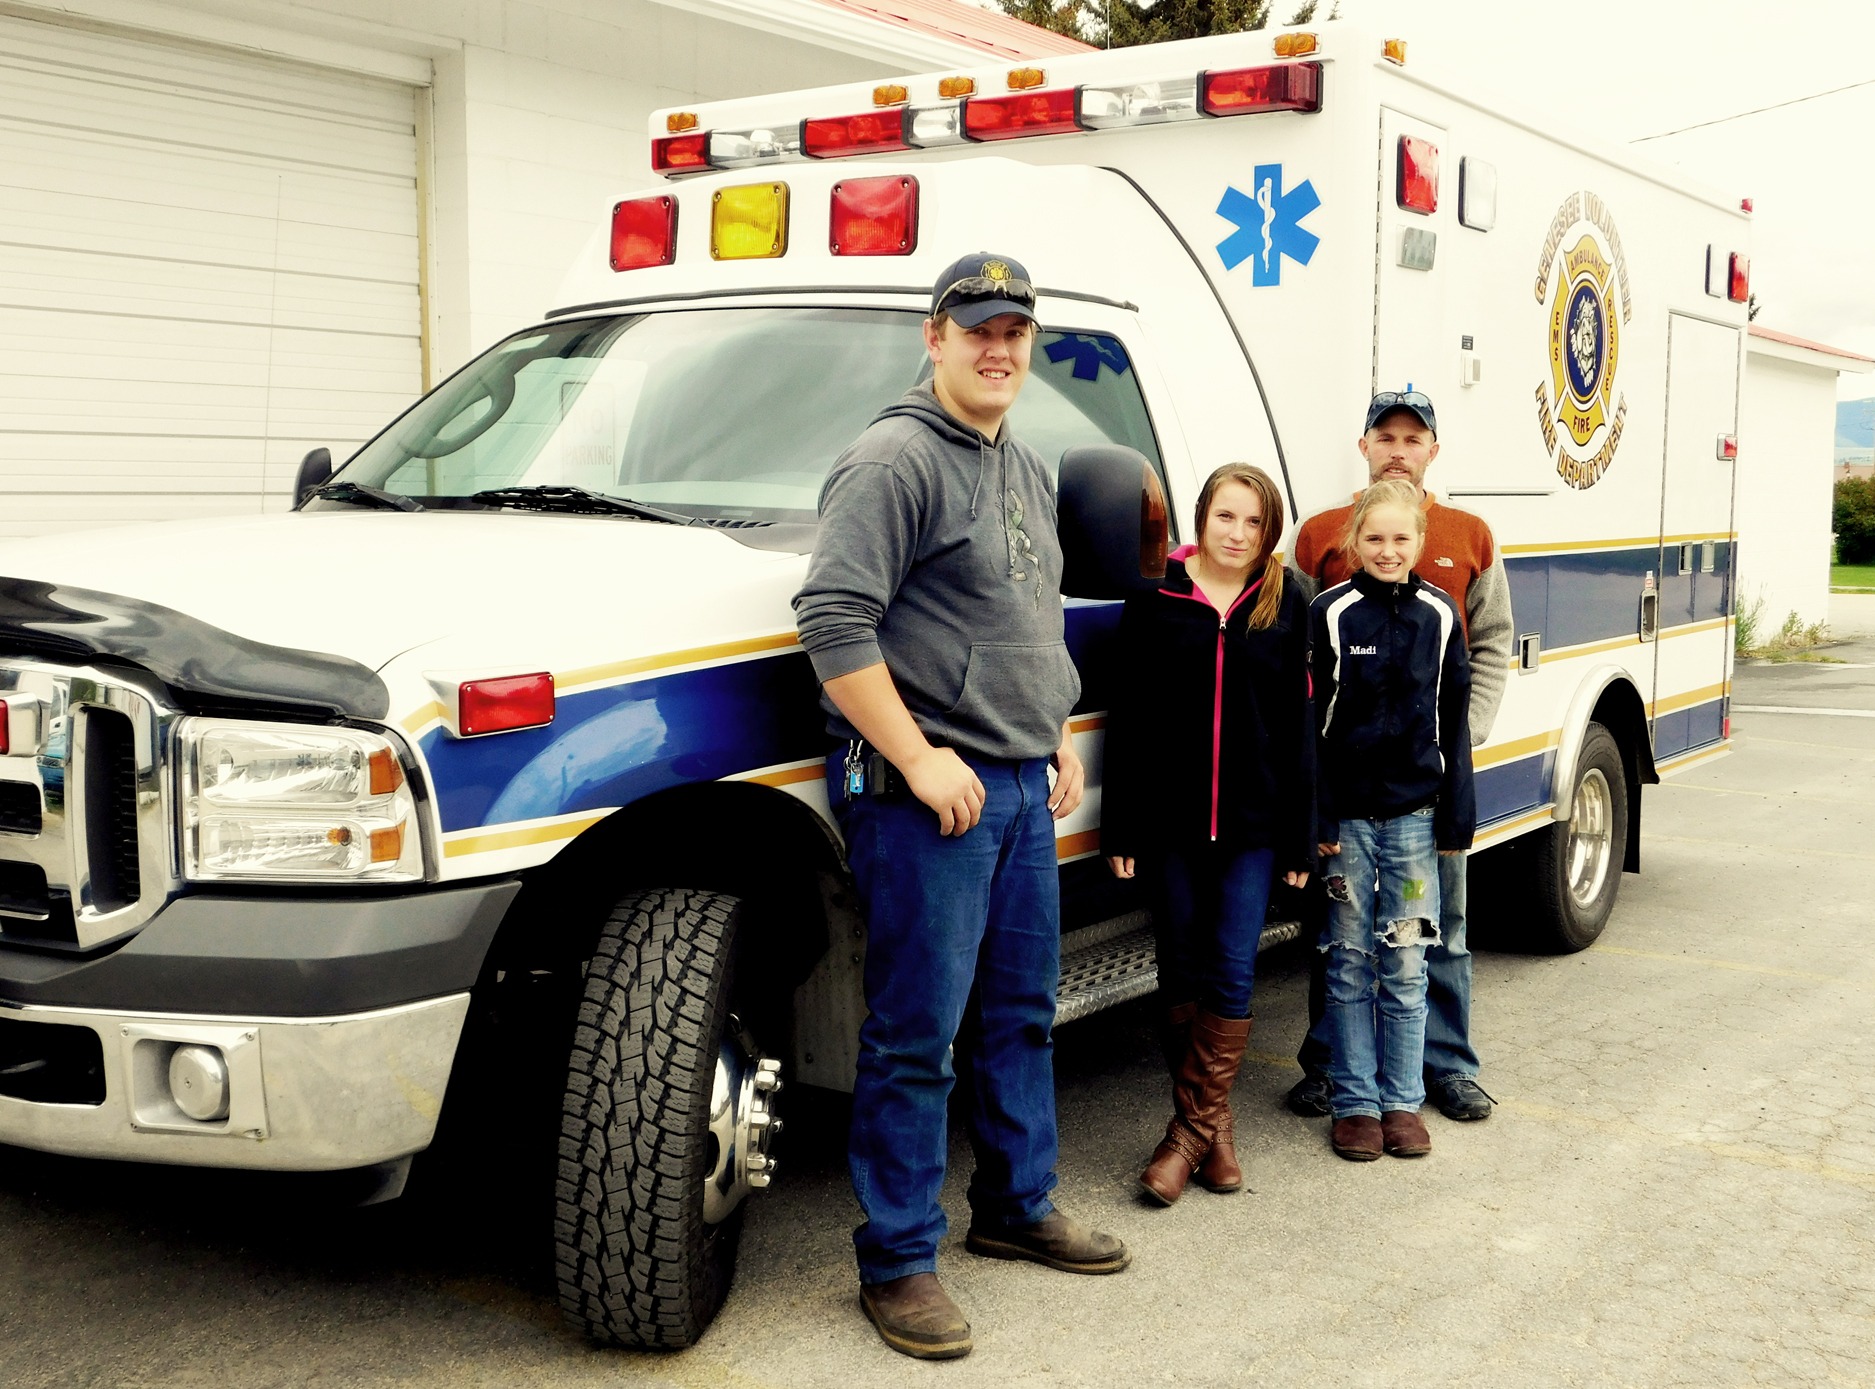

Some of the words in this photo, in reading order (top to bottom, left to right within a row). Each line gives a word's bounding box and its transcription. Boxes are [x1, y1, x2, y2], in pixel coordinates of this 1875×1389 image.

[1535, 191, 1581, 305] GENESEE
[1584, 190, 1632, 326] VOLUNTEER
[1570, 249, 1606, 282] AMBULANCE
[1552, 311, 1560, 362] EMS
[1605, 299, 1615, 391] RESCUE
[1535, 380, 1558, 458] FIRE
[1556, 391, 1628, 490] DEPARTMENT
[1572, 414, 1591, 434] FIRE
[565, 445, 612, 466] PARKING
[1349, 645, 1377, 655] Madi
